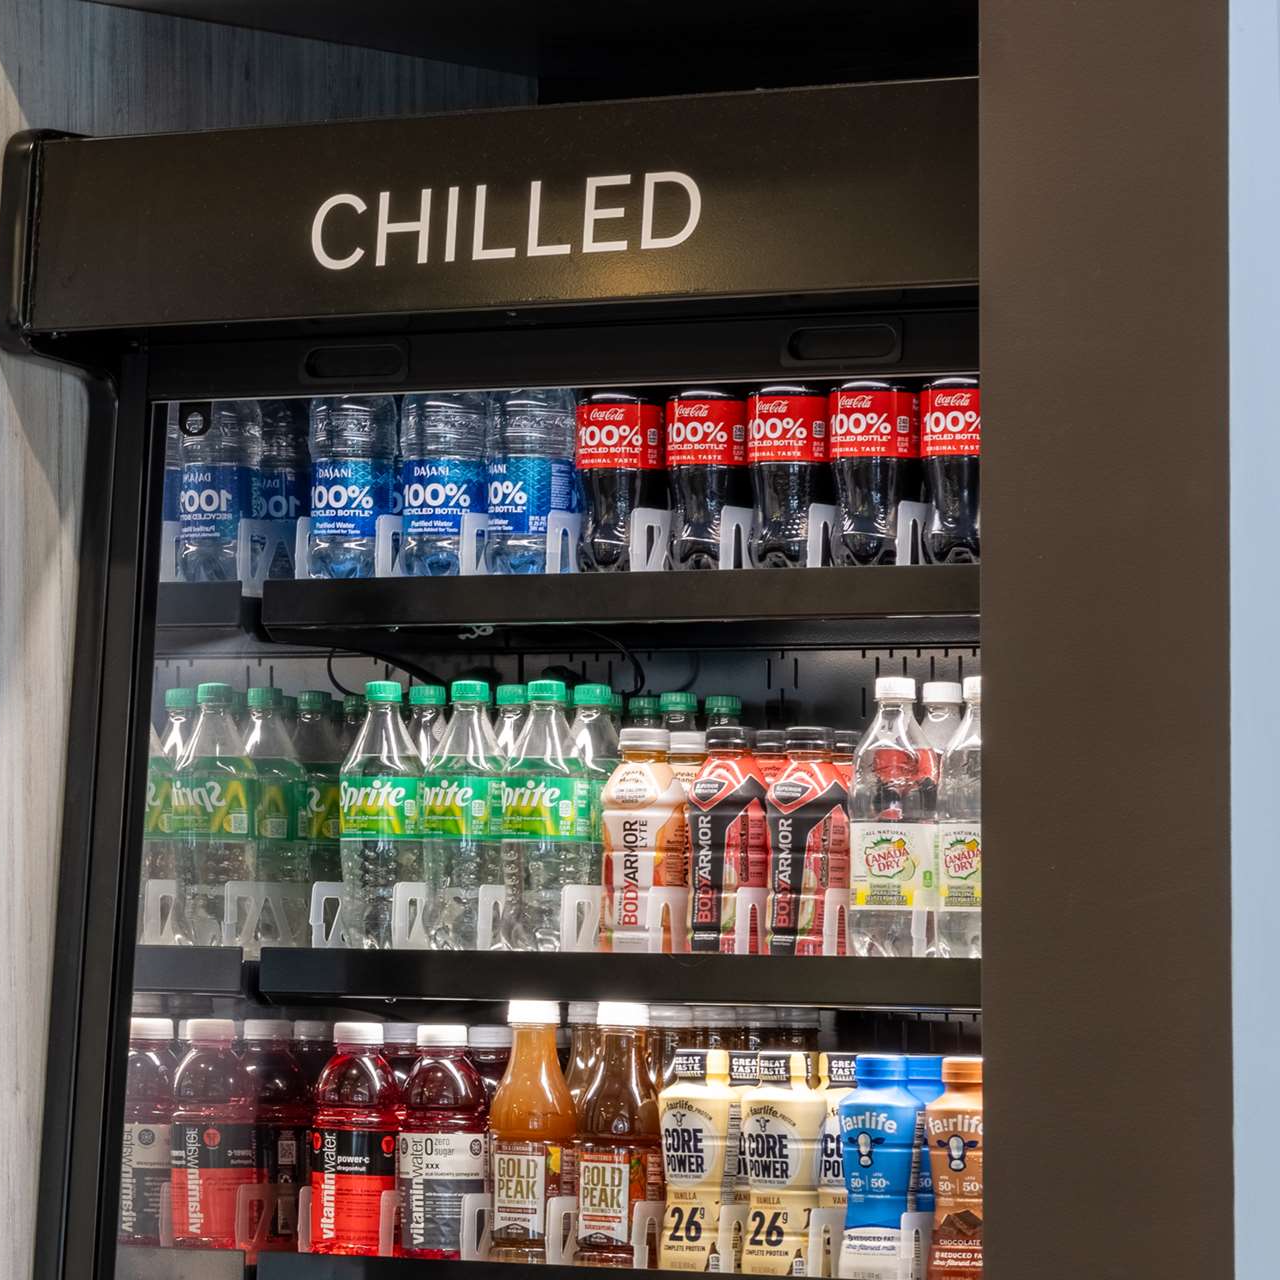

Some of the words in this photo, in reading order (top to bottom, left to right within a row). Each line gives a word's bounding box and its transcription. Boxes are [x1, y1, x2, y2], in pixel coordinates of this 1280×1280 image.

[311, 171, 702, 271] CHILLED
[934, 392, 971, 406] Coca-Cola
[590, 407, 624, 422] Coca-Cola
[675, 404, 710, 418] Coca-Cola
[667, 421, 728, 443] 100%
[748, 417, 807, 440] 100%
[831, 413, 892, 435] 100%
[579, 425, 643, 447] 100%
[318, 467, 353, 480] DASANI
[414, 466, 449, 478] DASANI
[341, 780, 407, 808] Sprite
[424, 780, 473, 808] prite
[640, 819, 648, 848] LYTE
[864, 848, 910, 868] CANADA
[877, 859, 901, 872] DRY
[953, 861, 974, 873] DRY
[622, 819, 640, 927] BODYARMOR
[696, 815, 712, 924] BODYARMOR
[665, 1100, 695, 1113] fairlife
[749, 1104, 779, 1118] fairlife
[840, 1111, 898, 1133] fairlife
[665, 1127, 703, 1155] CORE
[748, 1133, 788, 1159] CORE
[337, 1155, 370, 1166] power-c
[434, 1148, 455, 1158] sugar
[498, 1158, 538, 1179] GOLD
[665, 1155, 705, 1174] POWER
[749, 1160, 790, 1179] POWER
[321, 1131, 337, 1240] vitaminwater
[583, 1166, 623, 1188] GOLD
[410, 1137, 425, 1245] vitaminwater
[498, 1179, 537, 1200] PEAK
[582, 1187, 624, 1208] PEAK
[673, 1192, 696, 1201] VANILLA
[683, 1244, 706, 1252] PROTEIN
[939, 1238, 982, 1246] CHOCOLATE
[764, 1249, 789, 1257] PROTEIN
